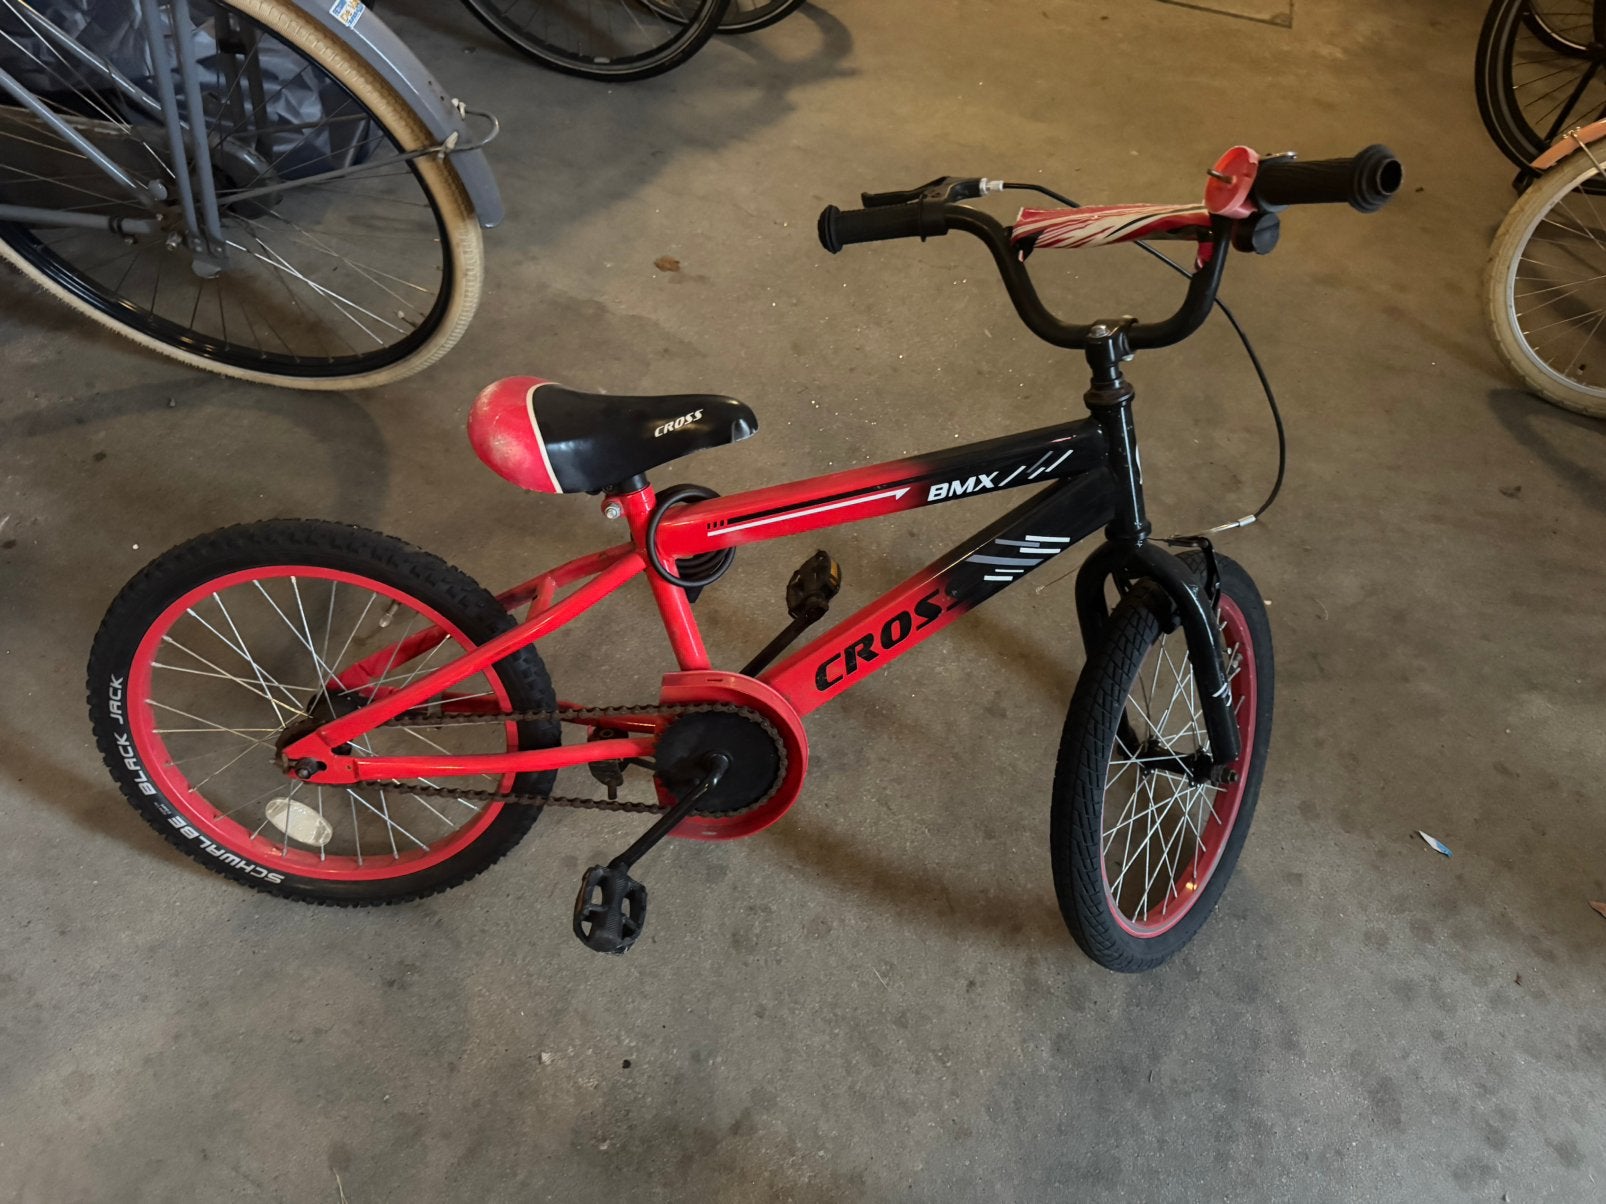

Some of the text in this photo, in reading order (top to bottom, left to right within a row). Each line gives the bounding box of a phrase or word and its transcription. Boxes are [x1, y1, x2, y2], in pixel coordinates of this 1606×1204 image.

[654, 408, 704, 438] CROSS
[927, 471, 999, 502] BMX
[108, 673, 285, 884] SCHWALBE BLACK JACK
